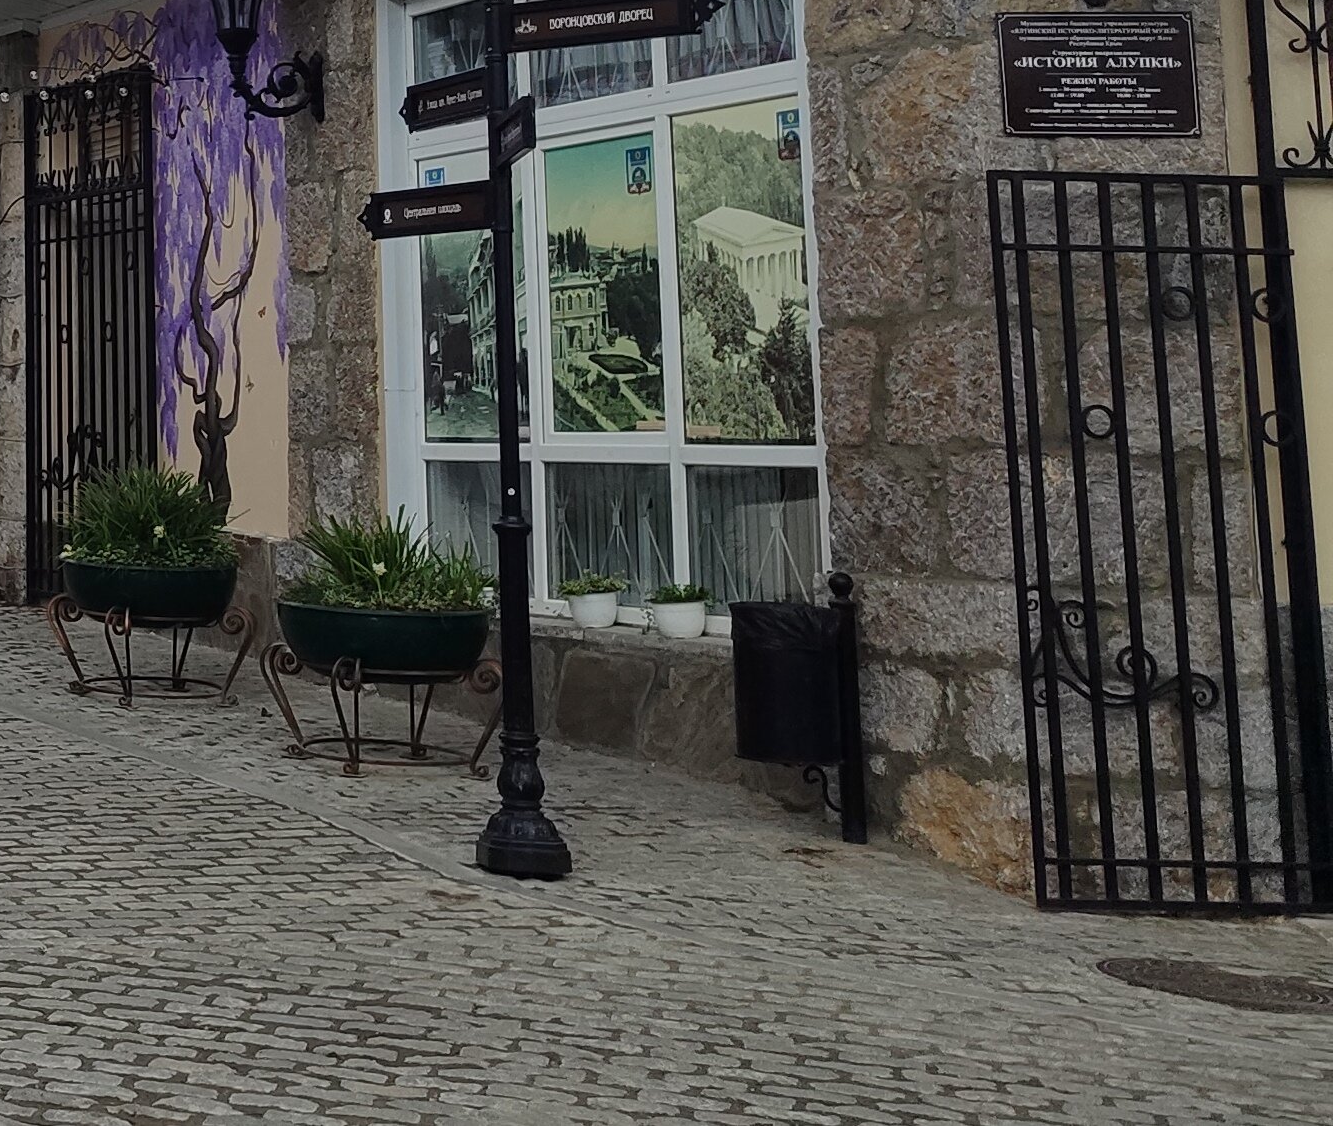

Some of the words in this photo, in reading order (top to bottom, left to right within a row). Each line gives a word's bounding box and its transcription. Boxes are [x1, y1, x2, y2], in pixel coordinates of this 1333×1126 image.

[549, 12, 616, 30] ВОРОНЦОВСКИЙ
[618, 8, 654, 24] ДВОРЕЦ
[1013, 56, 1098, 69] «ИСТОРИЯ
[1105, 57, 1182, 69] АЛУПКИ»
[1098, 77, 1137, 86] РАБОТЫ
